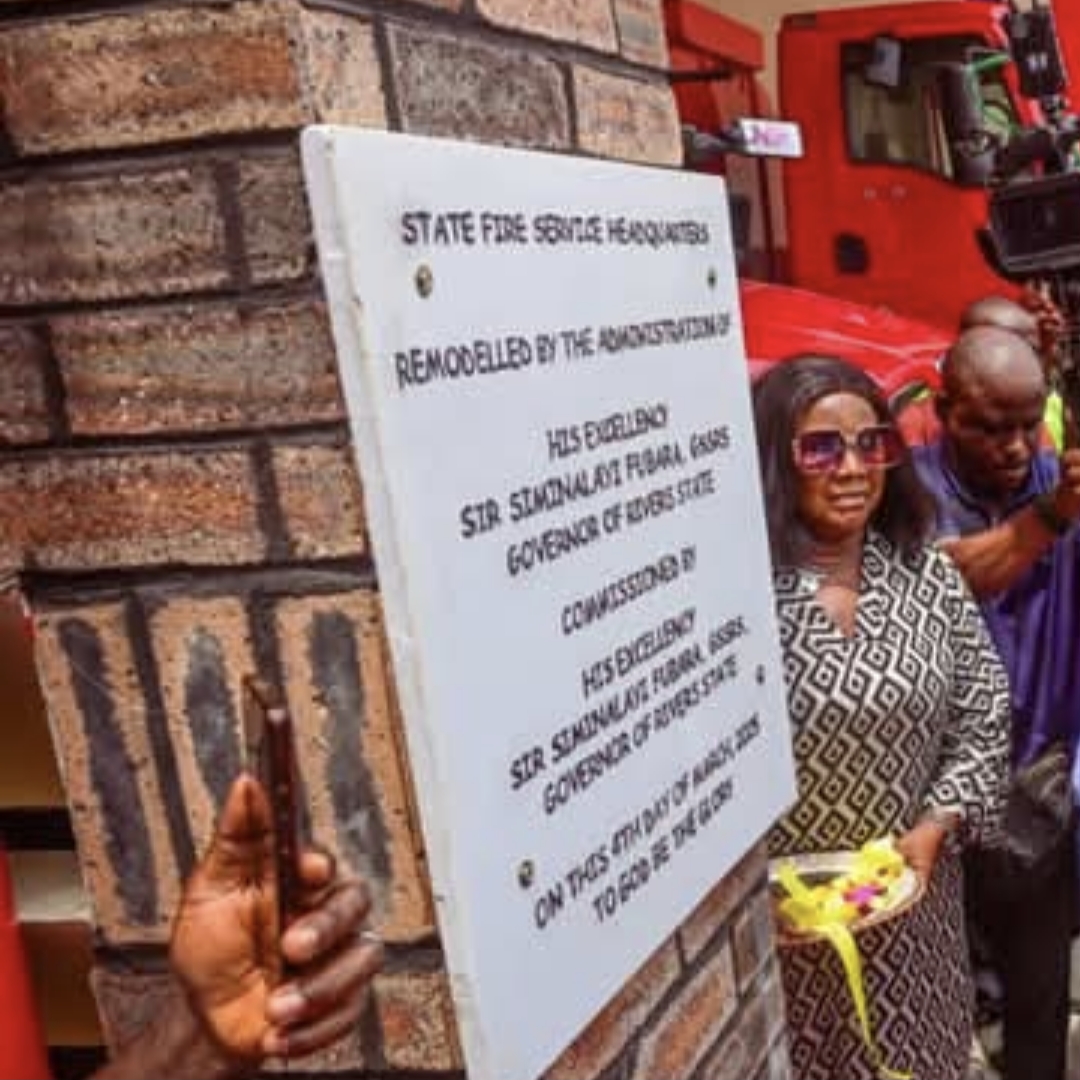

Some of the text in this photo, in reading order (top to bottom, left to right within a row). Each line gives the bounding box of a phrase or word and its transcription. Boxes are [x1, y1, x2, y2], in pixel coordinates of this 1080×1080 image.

[401, 211, 474, 246] STATE
[483, 213, 527, 245] FIRE
[533, 213, 603, 244] SERVICE
[395, 335, 532, 390] REMODELLED
[537, 334, 558, 365] BY
[559, 328, 593, 359] THE
[547, 404, 668, 459] HIS EXCELLENCY
[461, 499, 502, 538] SIR
[510, 460, 622, 523] SIMINALAYI
[507, 470, 715, 576] GOVERNOR OF RIVERS STATE
[561, 546, 697, 635] COMMISSIONED BY
[581, 608, 696, 699] HIS EXCELLENCY
[510, 746, 545, 790] SIR
[551, 677, 649, 761] SIMINALAYI
[543, 655, 736, 814] GOVERNOR OF RIVERS STATE
[535, 873, 564, 928] ON
[566, 843, 610, 899] THIS
[643, 788, 670, 834] DAY
[672, 772, 688, 805] OF
[593, 887, 617, 921] TO
[620, 858, 651, 904] GOD
[652, 835, 670, 877] BE
[672, 809, 696, 848] THE
